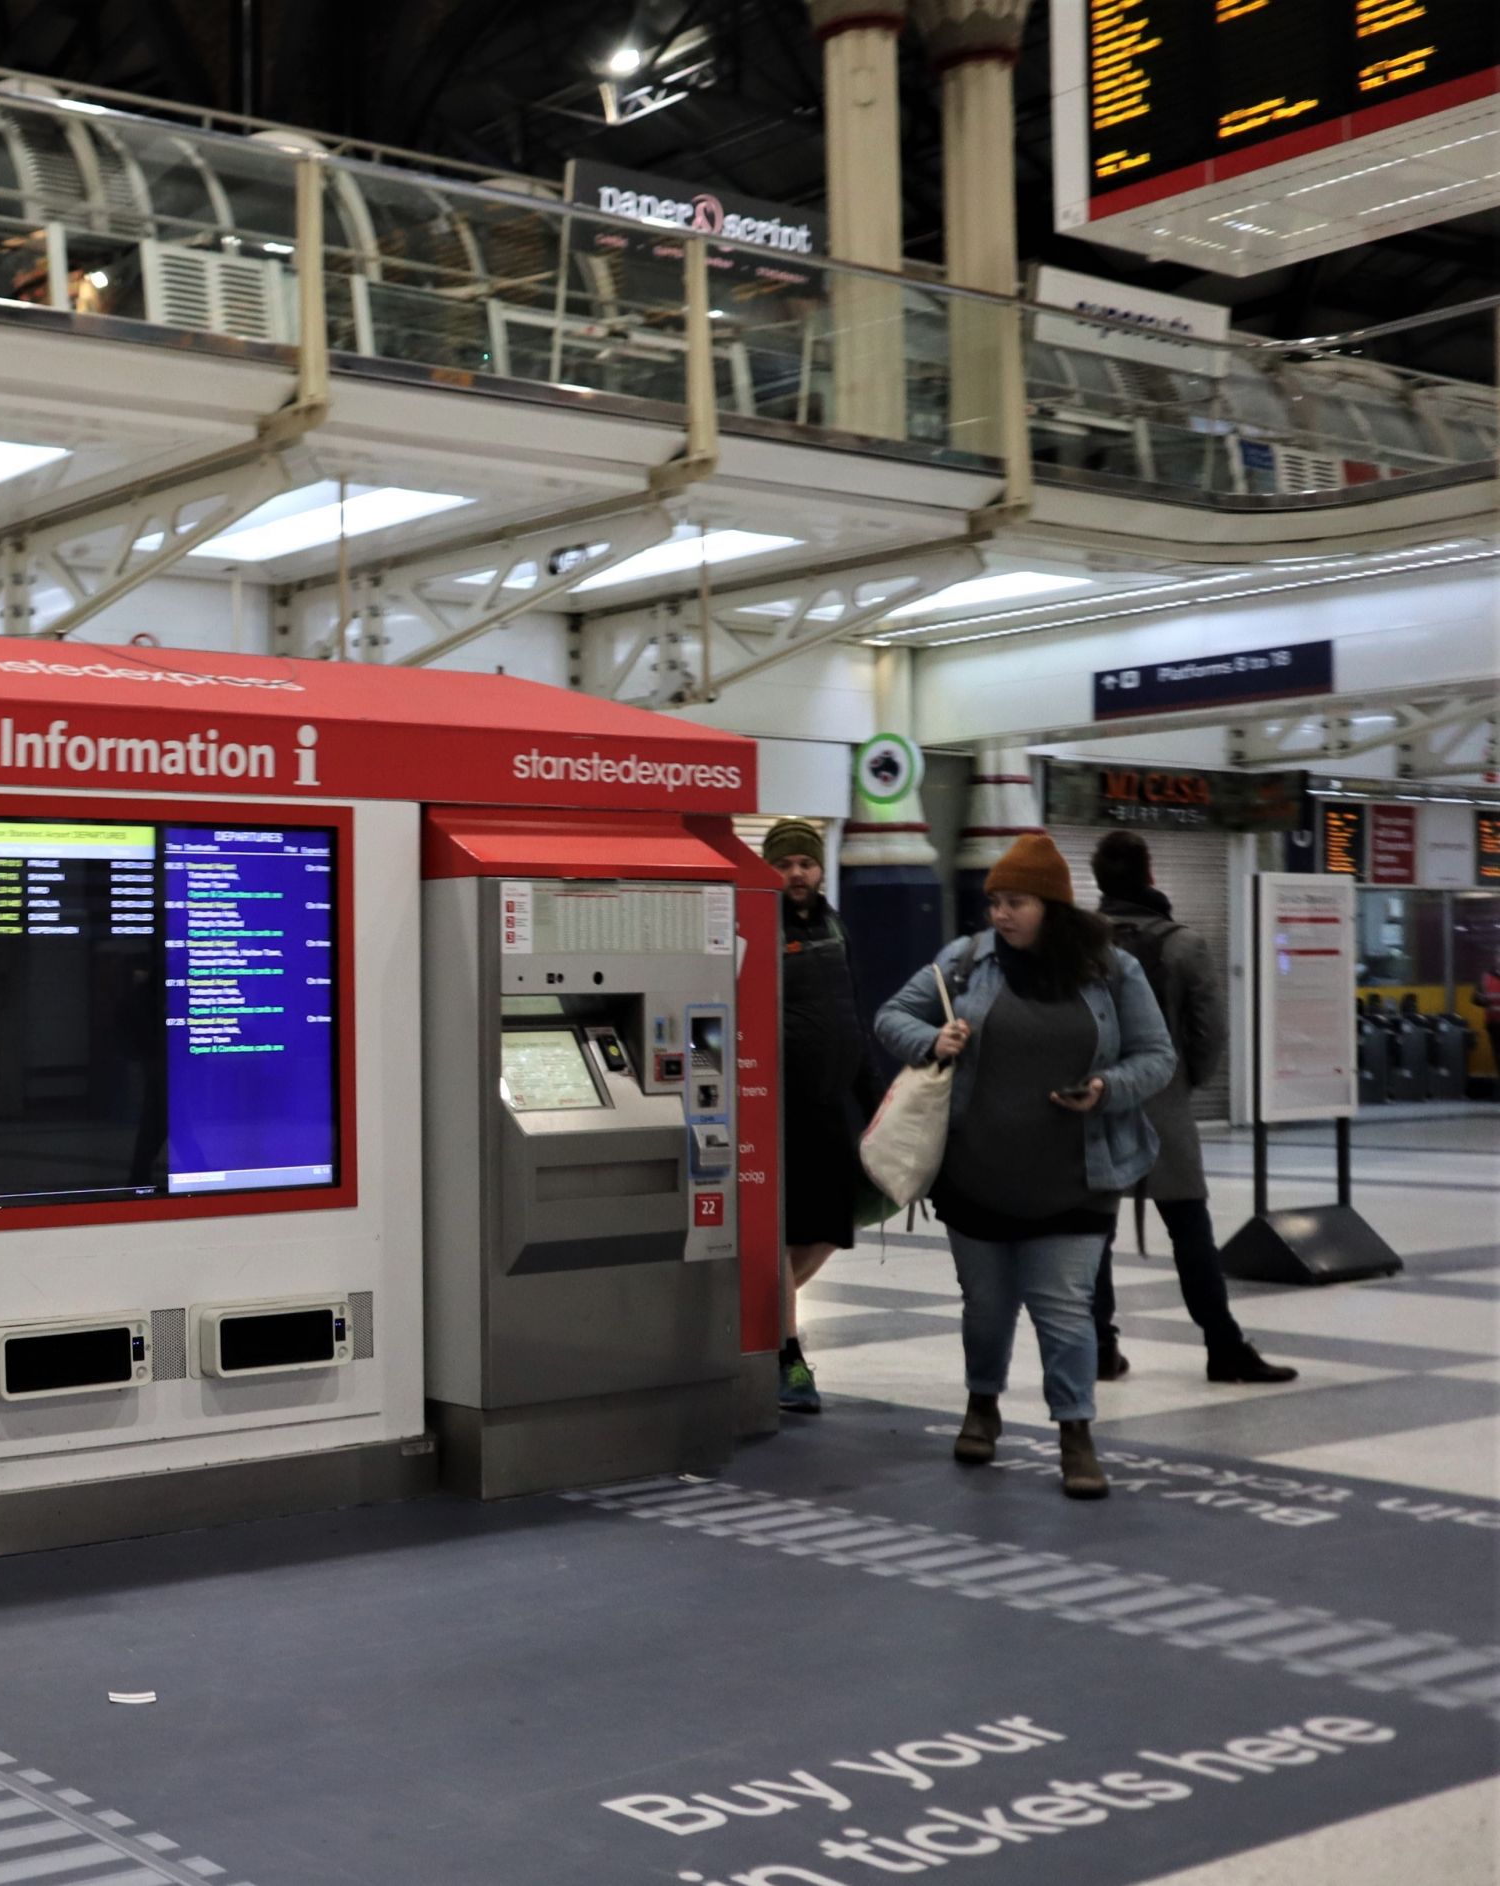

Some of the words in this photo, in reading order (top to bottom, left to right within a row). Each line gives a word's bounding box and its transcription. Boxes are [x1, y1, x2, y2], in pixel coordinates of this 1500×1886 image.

[1, 717, 276, 778] Information
[294, 724, 320, 786] i
[512, 748, 742, 792] stanstedexpress
[214, 831, 284, 842] DEPARTURES
[738, 1142, 755, 1153] ain
[702, 1201, 716, 1215] 22
[988, 1457, 1171, 1493] yur
[603, 1769, 852, 1836] Buy
[832, 1714, 1068, 1791] your
[819, 1770, 1193, 1874] tickets
[1137, 1715, 1397, 1784] here
